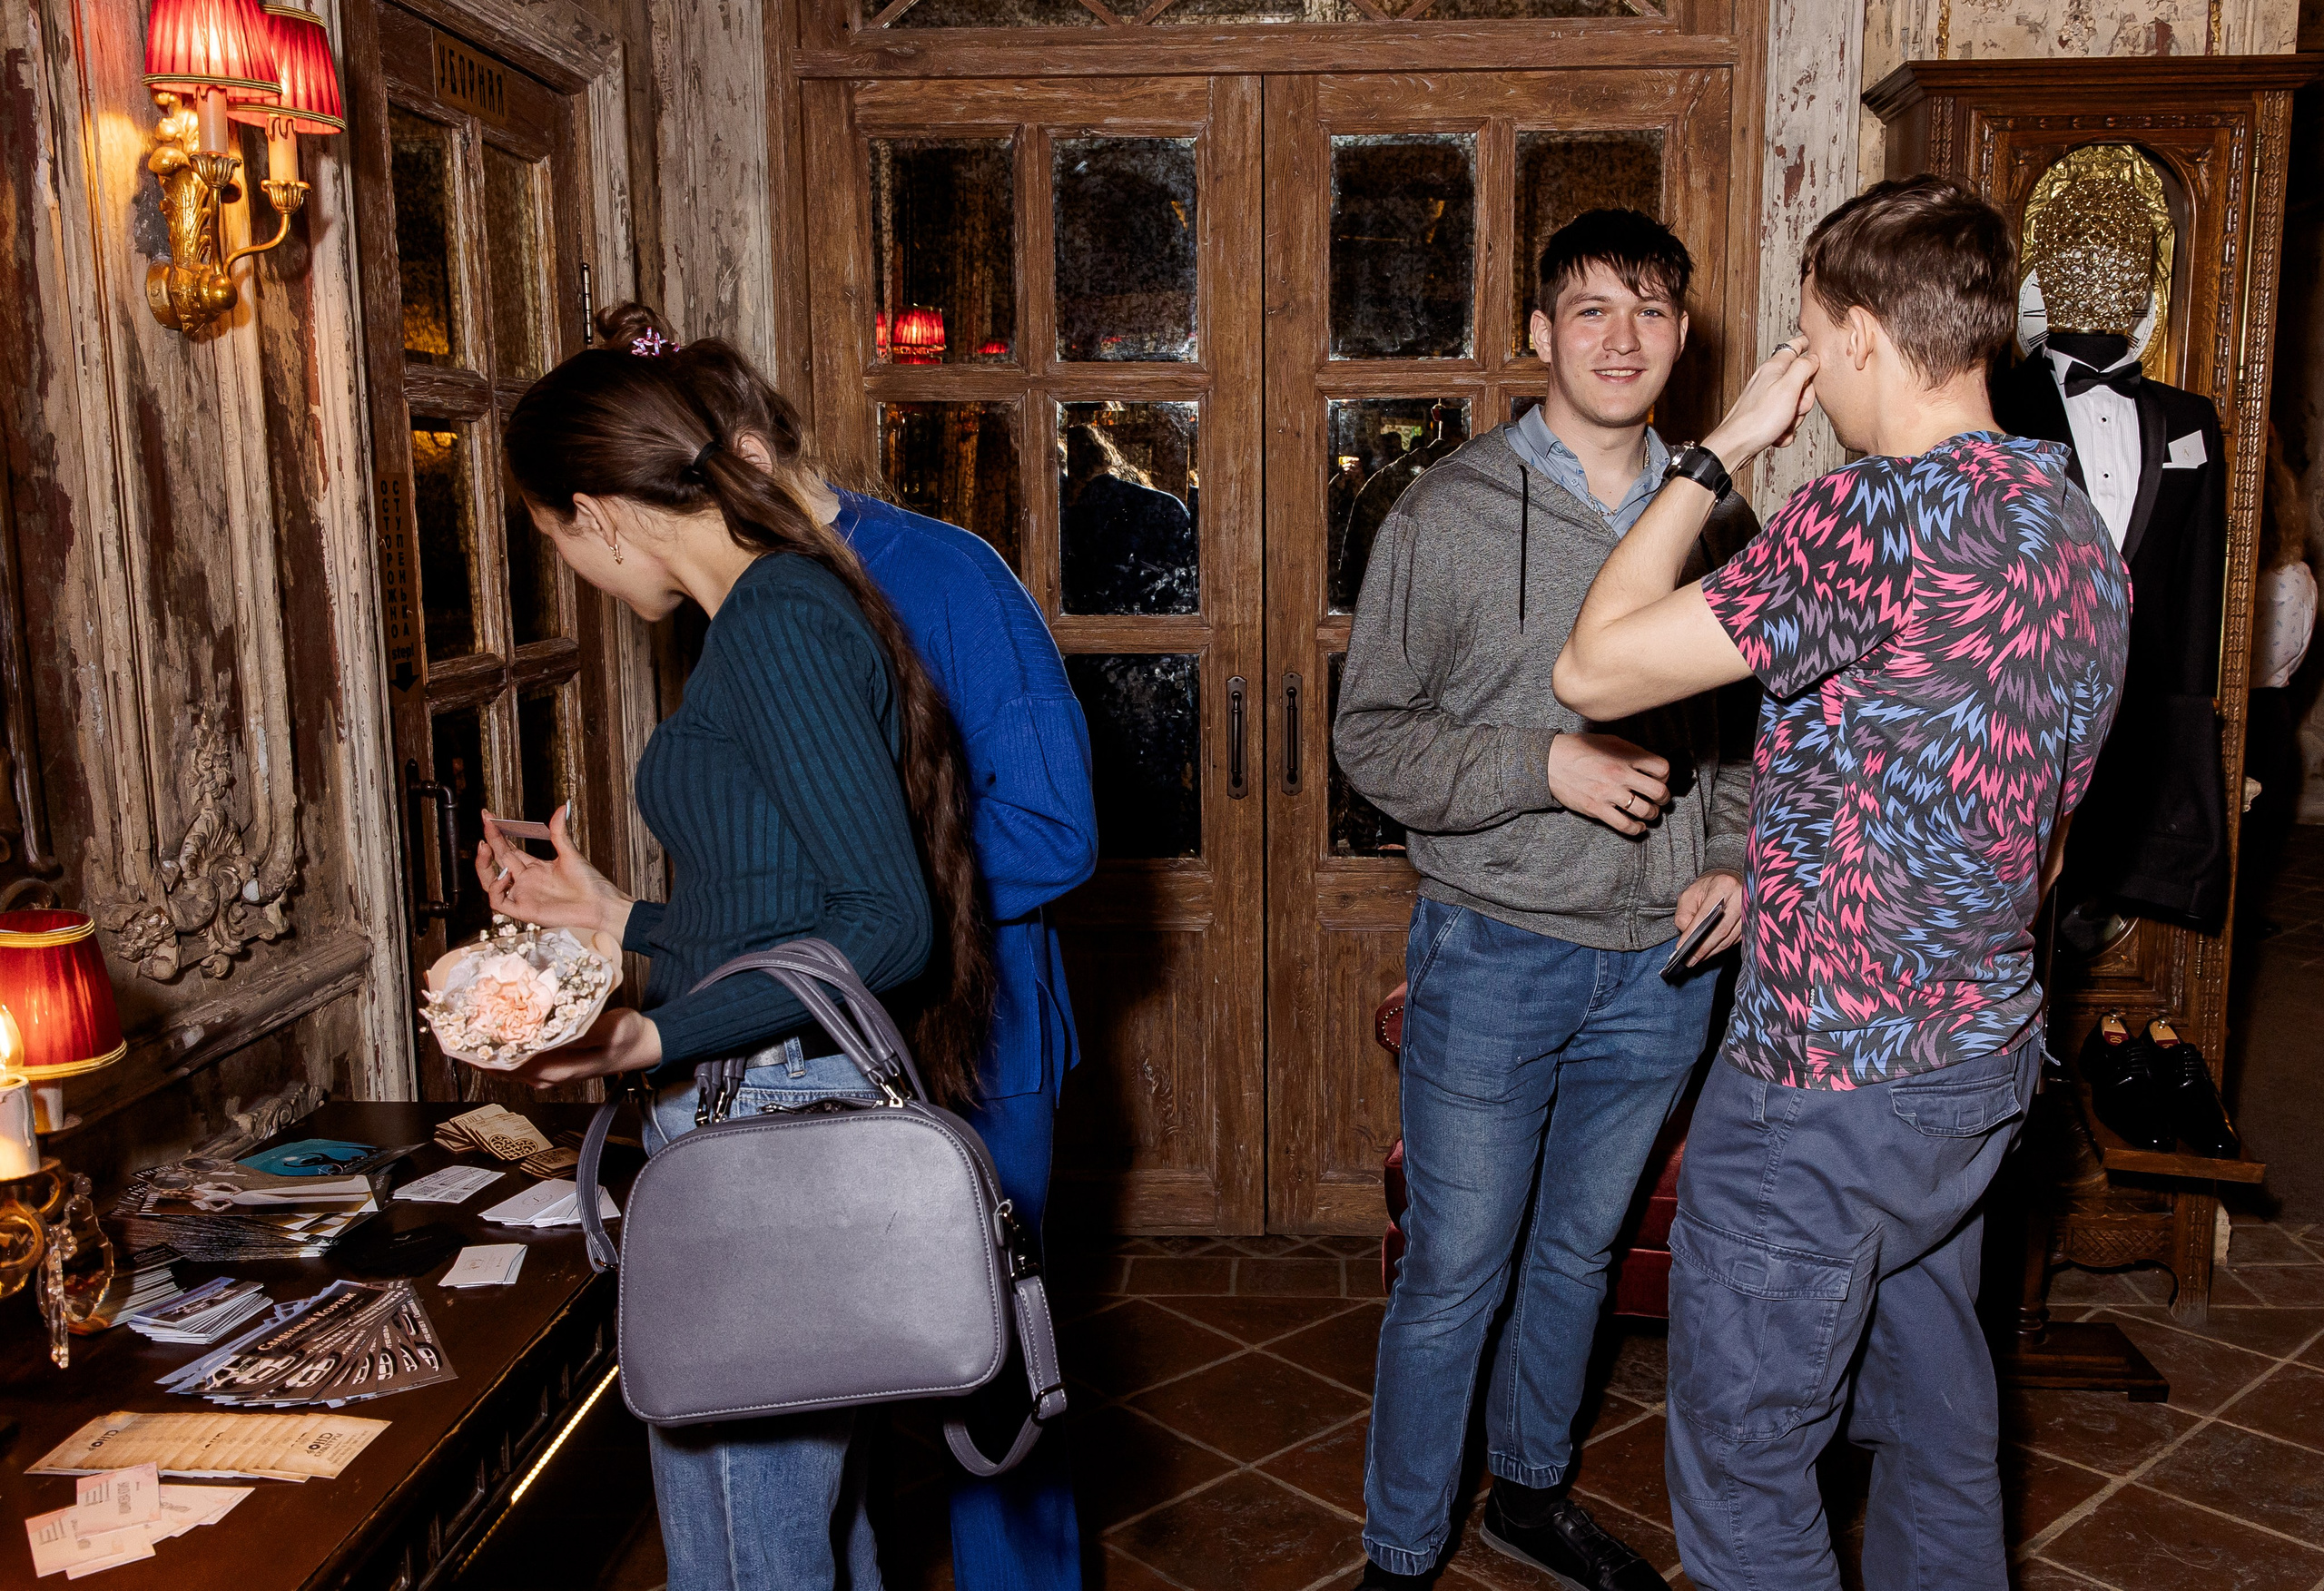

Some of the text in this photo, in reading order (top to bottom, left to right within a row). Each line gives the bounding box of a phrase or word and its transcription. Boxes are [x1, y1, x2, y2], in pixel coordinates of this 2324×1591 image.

[438, 44, 505, 117] УБОРНАЯ
[380, 480, 398, 639] ОСТОРОЖНО
[392, 480, 410, 637] СТУПЕНЬКА
[391, 642, 414, 662] step!
